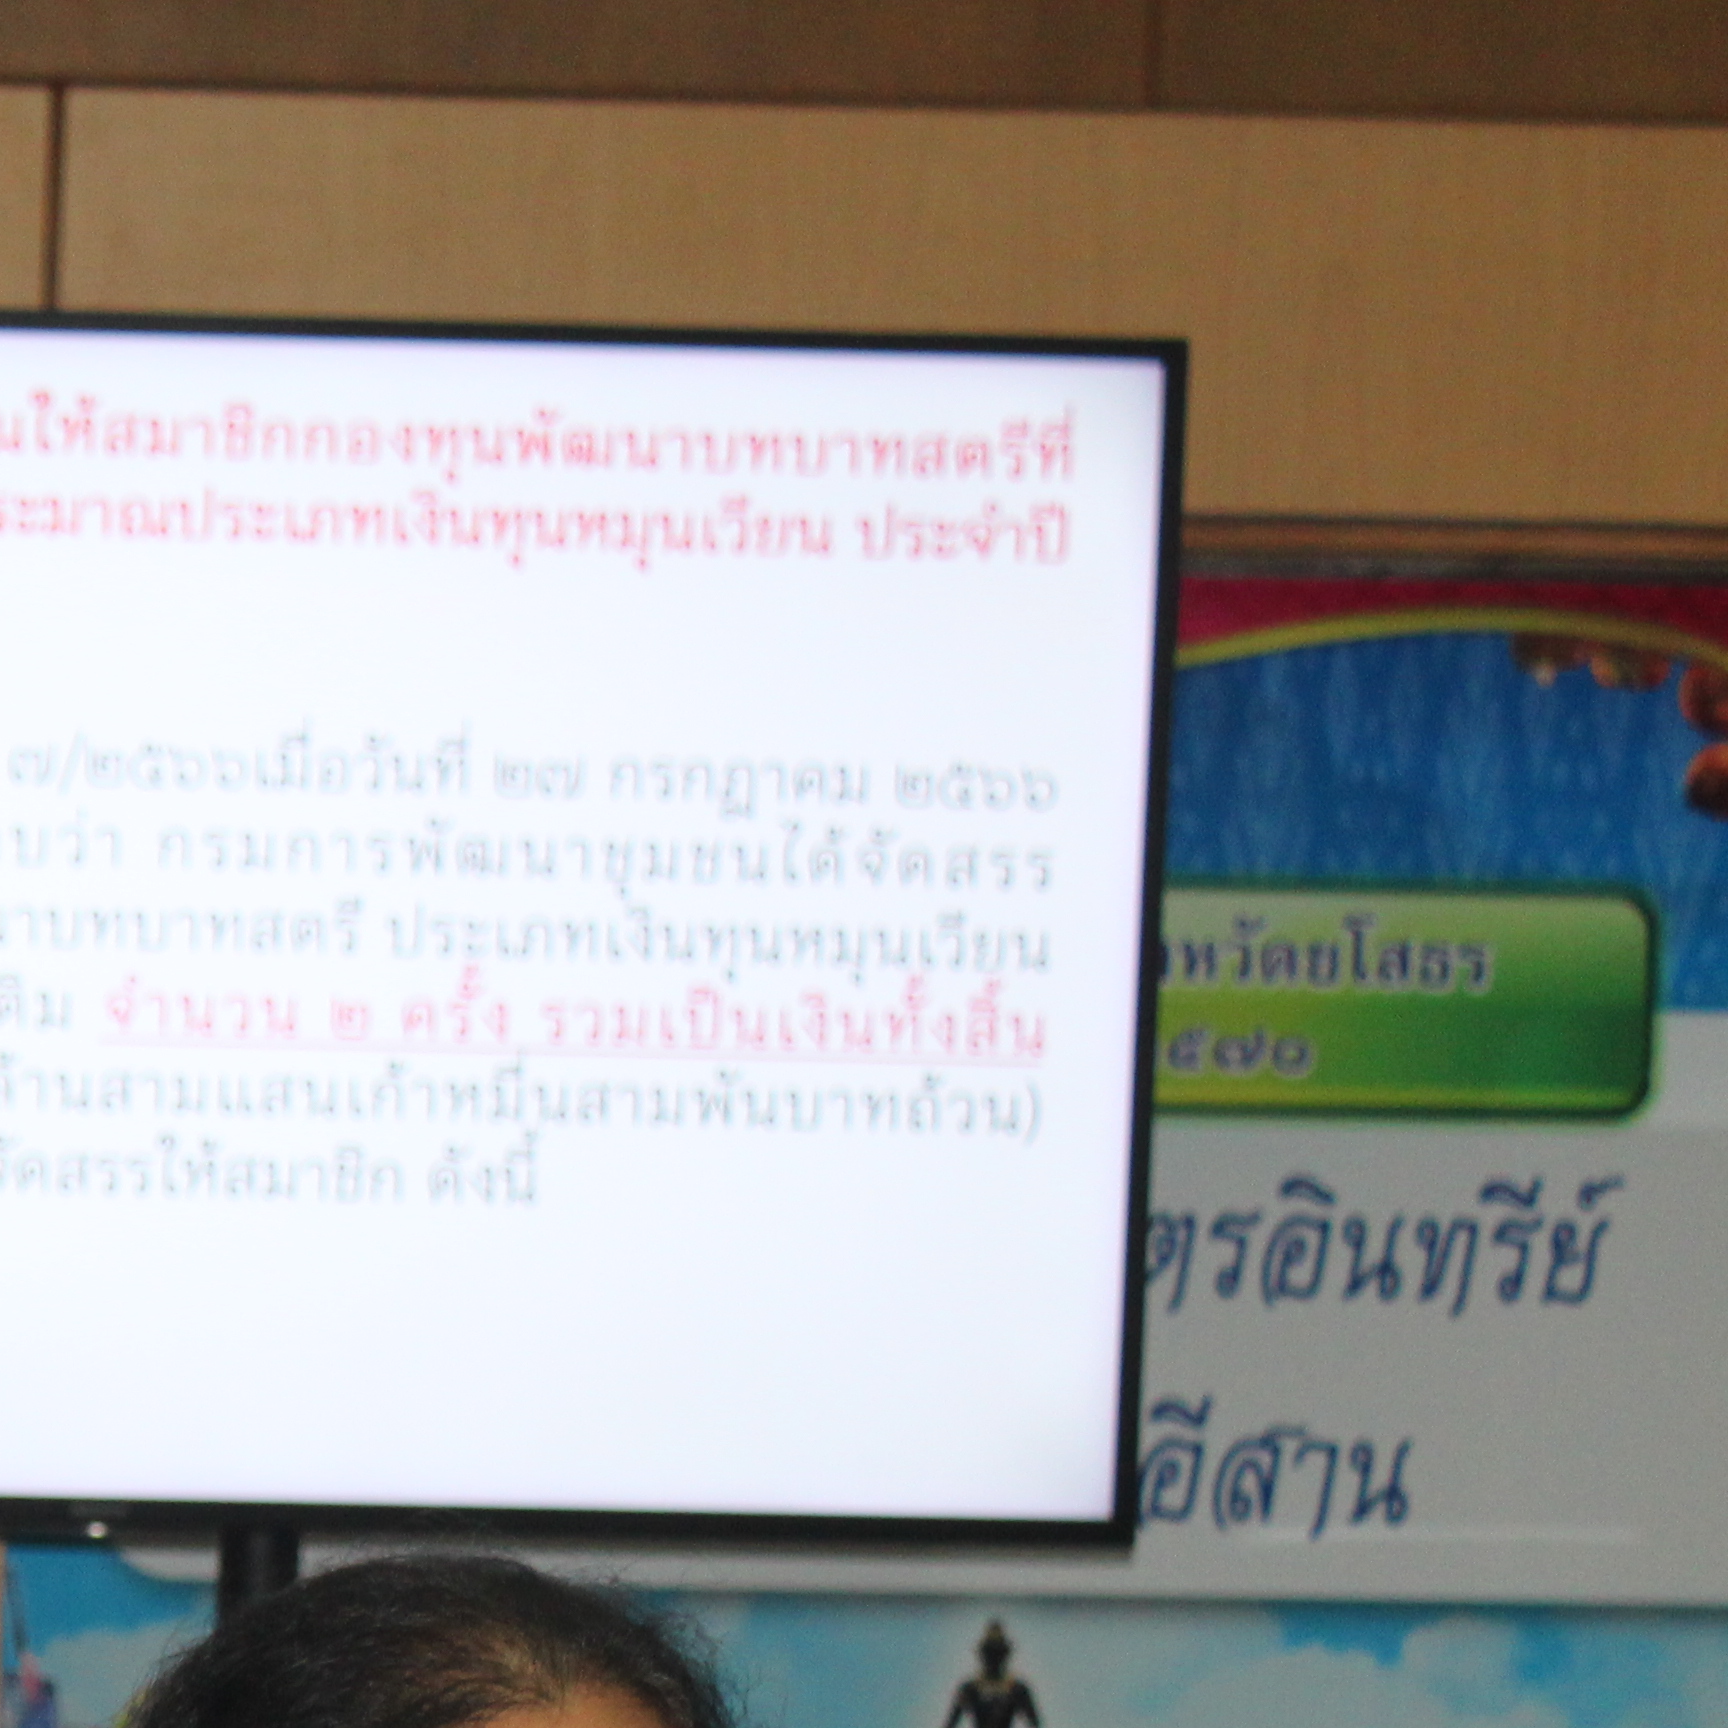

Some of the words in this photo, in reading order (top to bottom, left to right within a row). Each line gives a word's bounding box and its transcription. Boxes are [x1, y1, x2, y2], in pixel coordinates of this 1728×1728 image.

[857, 498, 1072, 561] ประจำปี
[895, 759, 1061, 812] ๒๕๖๖
[387, 897, 1054, 987] ประเภทเงินทุนหมุนเวียน
[104, 976, 298, 1038] จำนวน
[329, 996, 370, 1043] ๒
[401, 964, 507, 1044] ครั้ง
[426, 1132, 542, 1207] ดังนี้
